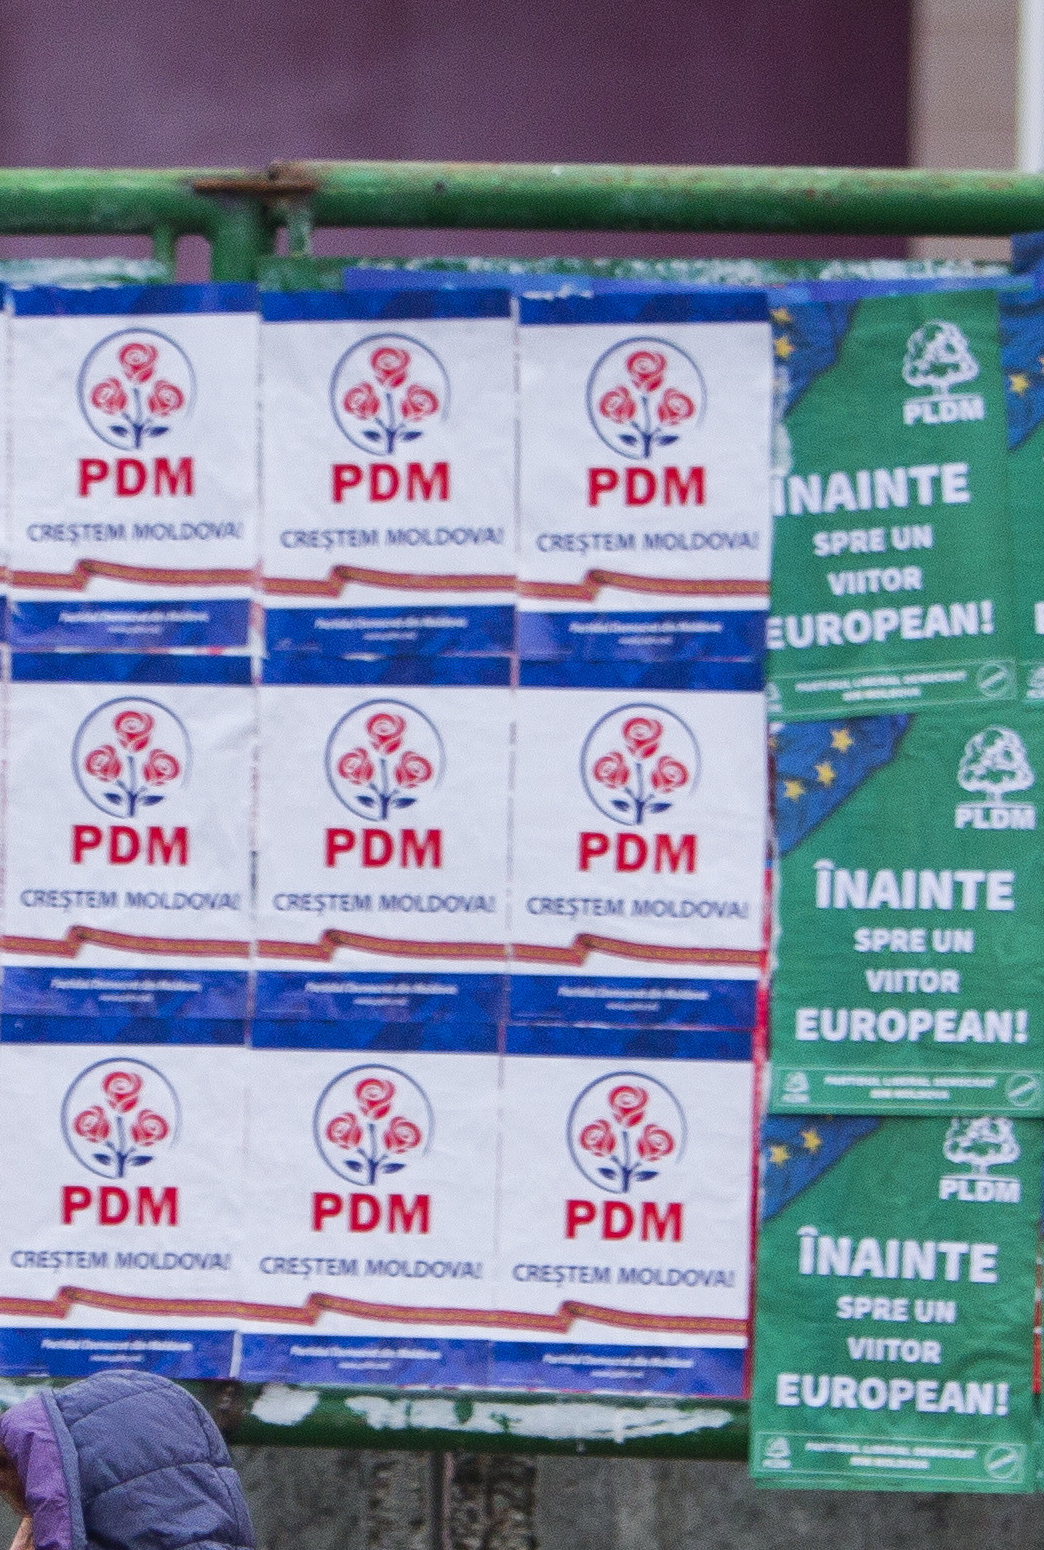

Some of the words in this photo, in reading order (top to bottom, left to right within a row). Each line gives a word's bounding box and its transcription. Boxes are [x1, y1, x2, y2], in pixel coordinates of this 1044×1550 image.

[905, 400, 983, 423] PLDM
[79, 457, 193, 497] PDM
[332, 462, 449, 502] PDM
[588, 466, 705, 506] PDM
[133, 522, 241, 540] MOLDOVA!
[387, 527, 504, 546] MOLDOVA!
[644, 532, 756, 551] MOLDOVA!
[815, 529, 882, 554] SPRE
[893, 527, 931, 548] UN
[829, 568, 920, 594] VIITOR
[767, 599, 996, 650] EUROPEAN!
[956, 808, 1034, 828] PLDM
[73, 825, 188, 865] PDM
[326, 828, 442, 868] PDM
[579, 832, 696, 872] PDM
[813, 859, 1015, 911] ÎNAINTE
[126, 891, 240, 910] MOLDOVA!
[380, 894, 495, 913] MOLDOVA!
[632, 899, 748, 919] MOLDOVA!
[856, 929, 924, 951] SPRE
[934, 931, 972, 951] UN
[867, 970, 958, 991] VIITOR
[797, 1009, 1026, 1042] EUROPEAN!
[941, 1179, 1019, 1201] PLDM
[62, 1185, 178, 1225] PDM
[313, 1192, 430, 1233] PDM
[566, 1199, 683, 1241] PDM
[116, 1252, 231, 1270] MOLDOVA!
[797, 1226, 998, 1284] ÎNAINTE
[366, 1259, 482, 1279] MOLDOVA!
[619, 1267, 734, 1287] MOLDOVA!
[839, 1297, 906, 1320] SPRE
[916, 1301, 954, 1321] UN
[849, 1339, 939, 1361] VIITOR
[778, 1374, 1007, 1414] EUROPEAN!
